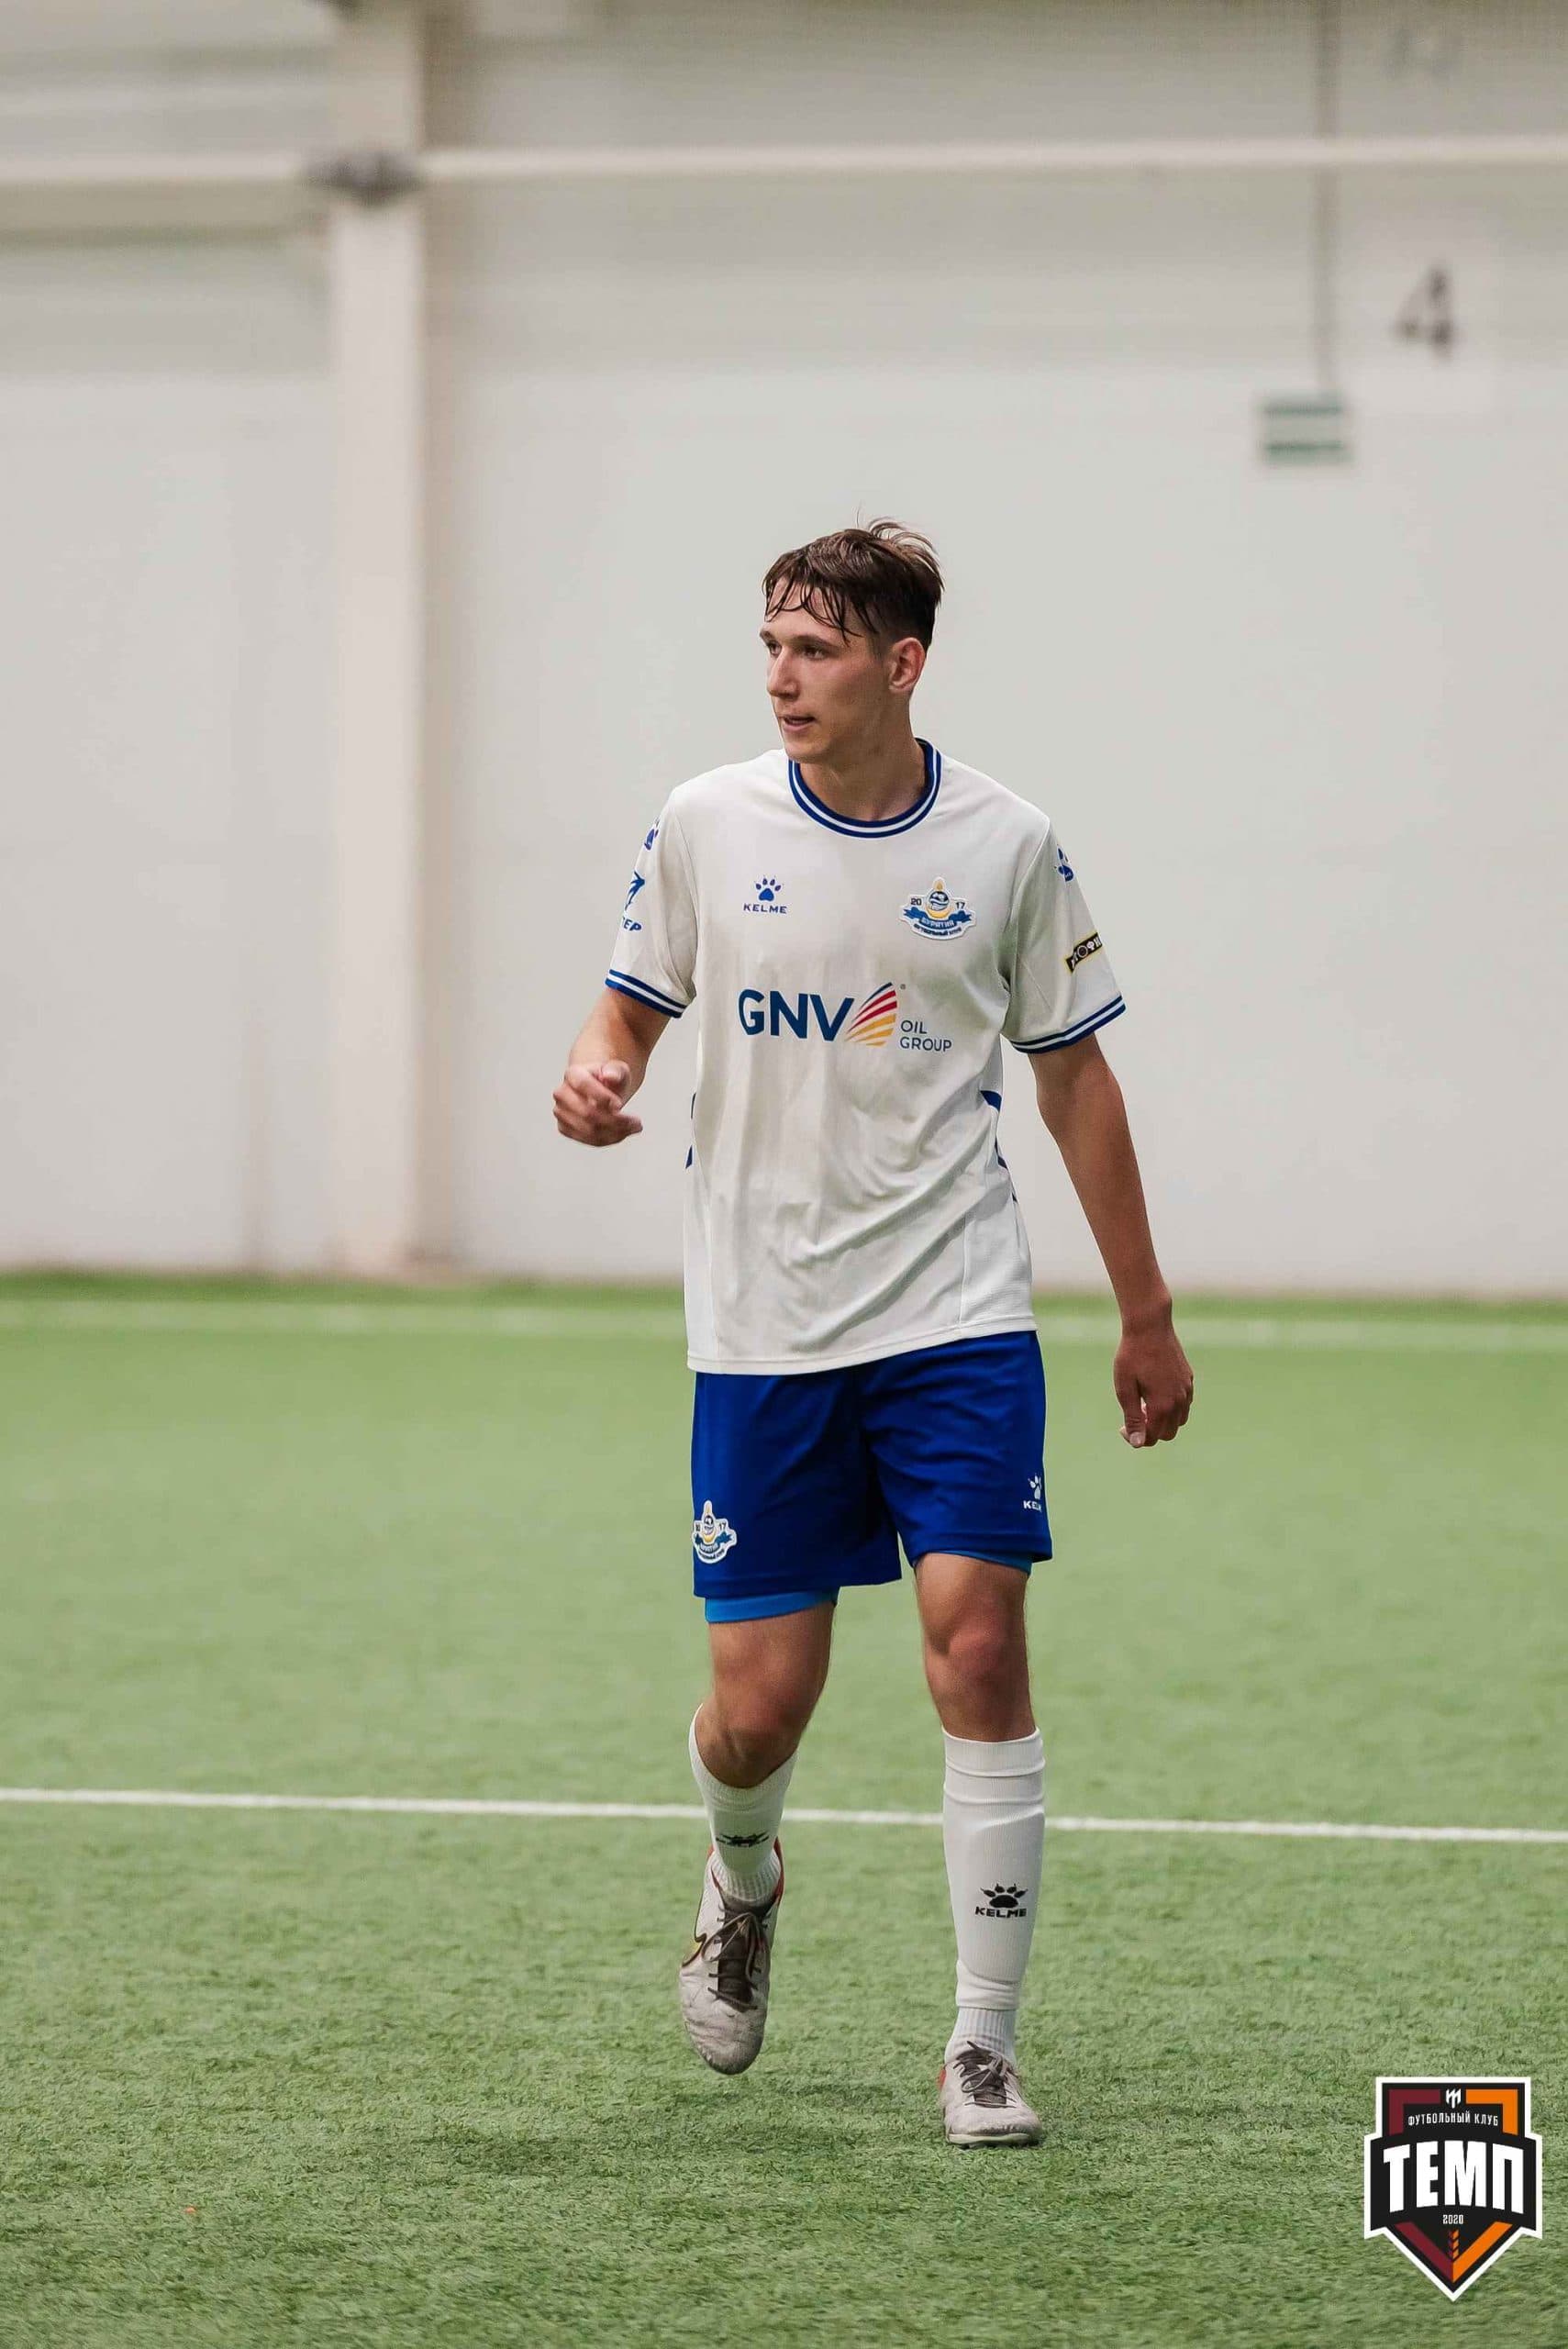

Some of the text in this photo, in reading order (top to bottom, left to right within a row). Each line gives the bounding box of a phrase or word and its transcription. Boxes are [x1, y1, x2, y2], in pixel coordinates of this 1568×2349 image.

[1394, 267, 1458, 359] 4
[743, 903, 787, 914] KELME
[738, 988, 855, 1042] GNV
[900, 1019, 928, 1035] OIL
[899, 1037, 952, 1052] GROUP
[974, 1906, 1028, 1919] KELME
